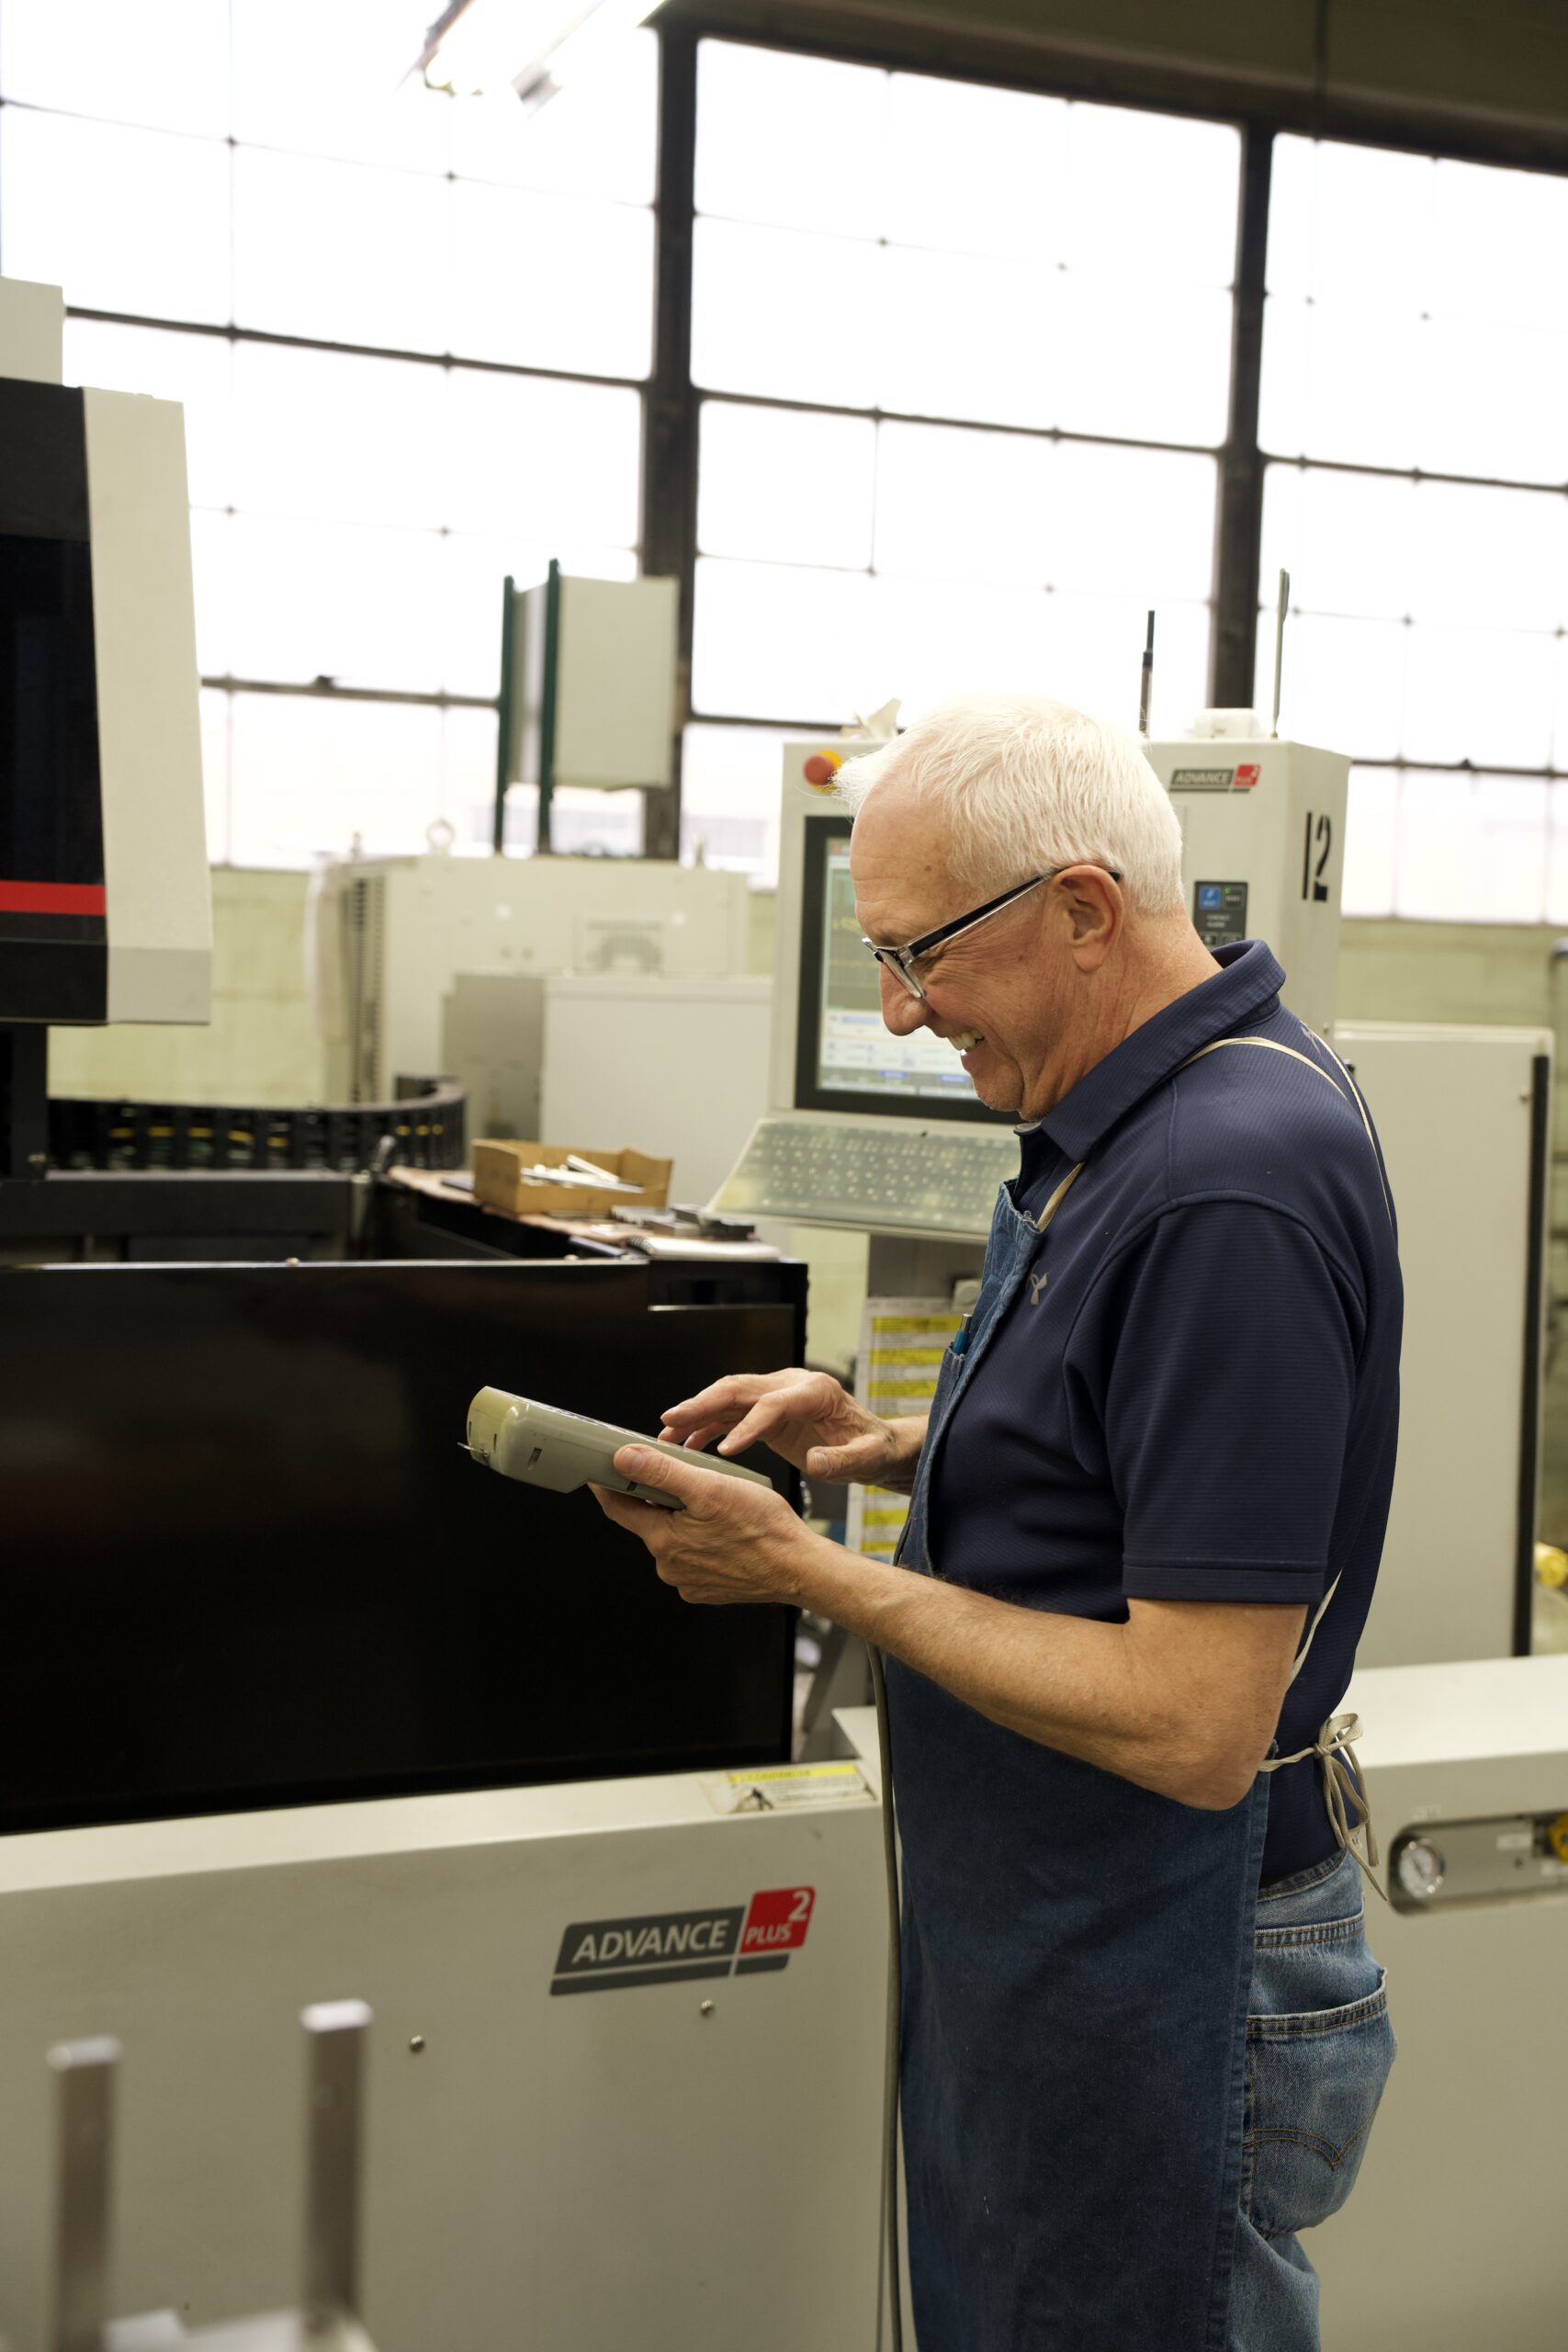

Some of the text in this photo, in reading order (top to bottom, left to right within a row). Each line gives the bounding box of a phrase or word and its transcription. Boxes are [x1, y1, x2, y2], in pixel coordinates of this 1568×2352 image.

[1174, 771, 1229, 784] ADVANCE
[1303, 812, 1331, 901] 12
[572, 1891, 810, 1964] ADVANCE PLUS 2
